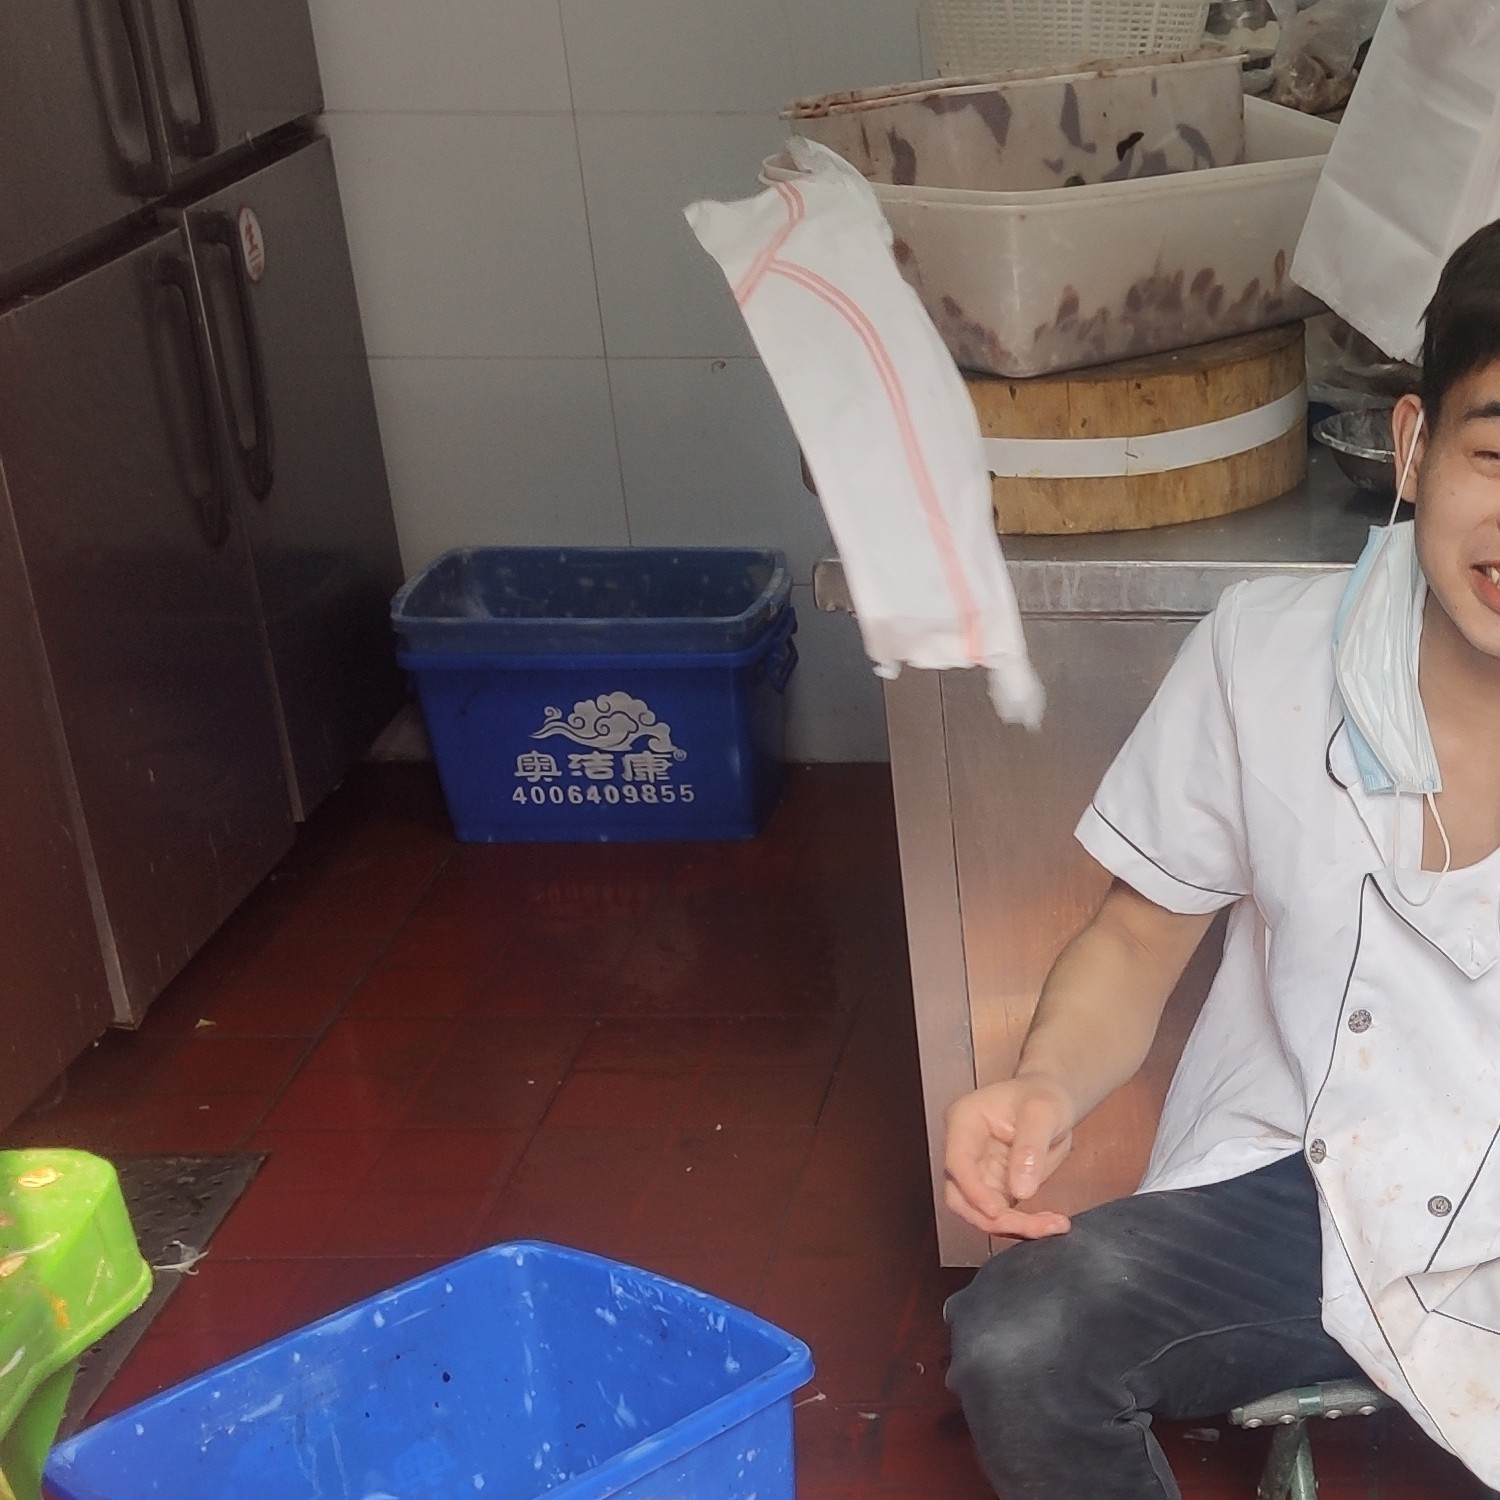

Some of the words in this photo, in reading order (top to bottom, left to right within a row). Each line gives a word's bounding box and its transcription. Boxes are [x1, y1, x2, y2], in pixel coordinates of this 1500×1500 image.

[513, 750, 674, 783] 奥洁康
[512, 784, 695, 804] 4006409855
